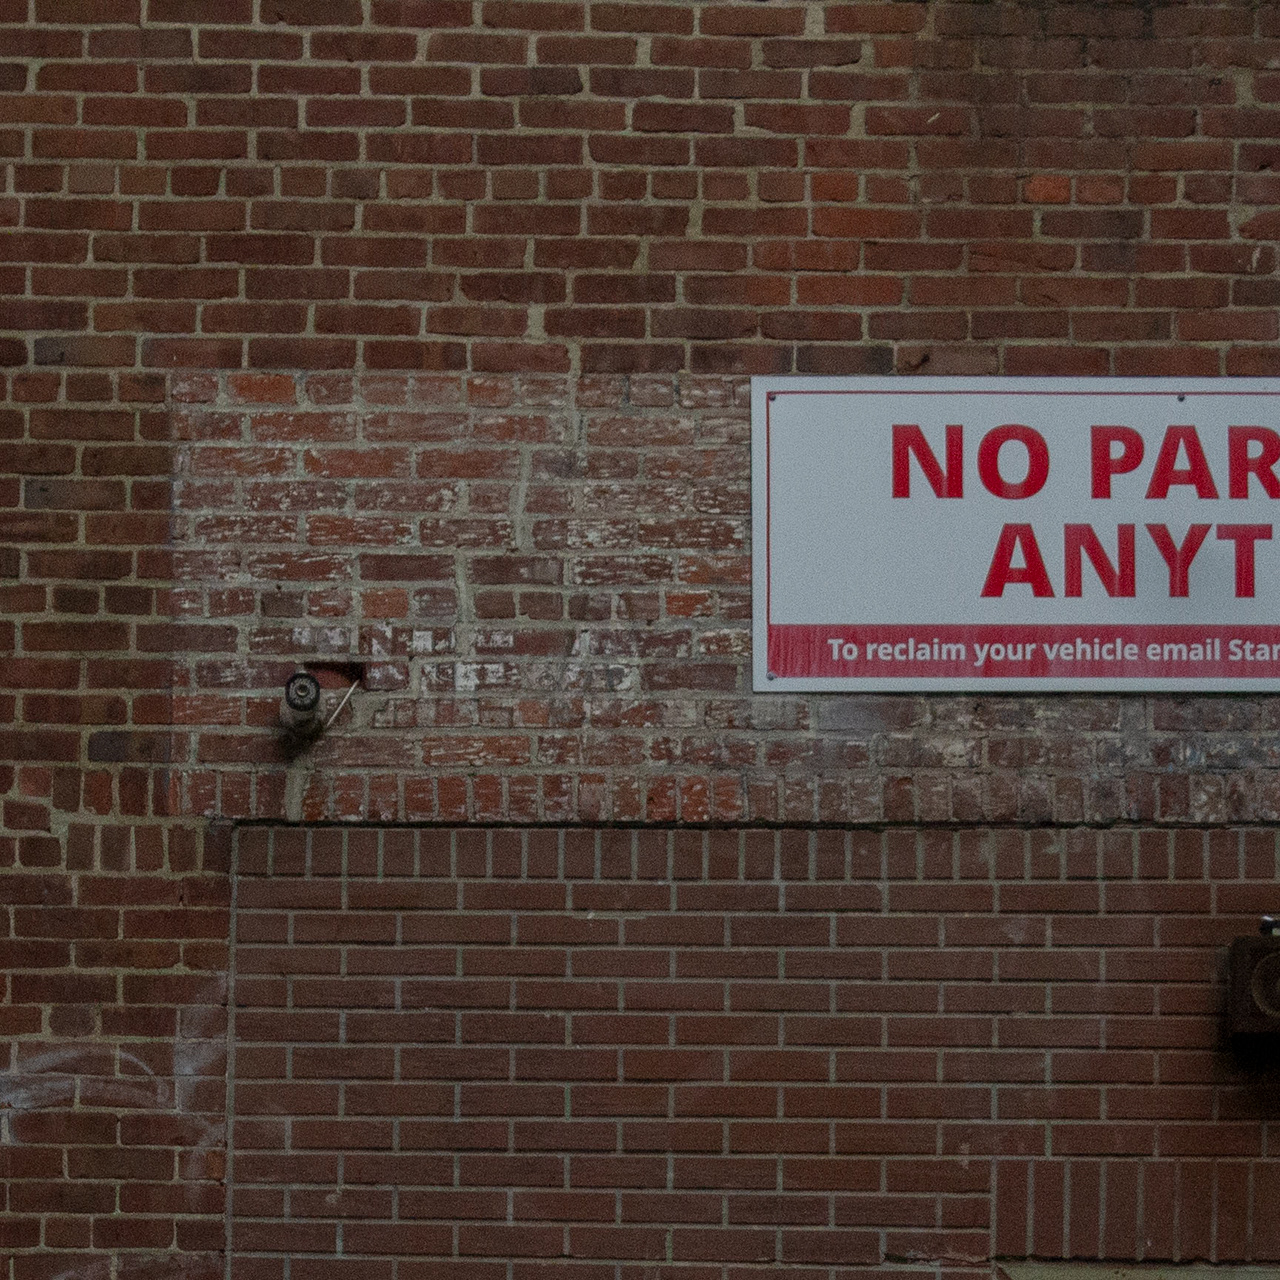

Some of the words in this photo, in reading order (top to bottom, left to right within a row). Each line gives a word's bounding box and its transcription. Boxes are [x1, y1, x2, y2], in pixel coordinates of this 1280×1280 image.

[890, 424, 1051, 500] NO
[827, 638, 858, 661] To
[865, 637, 967, 661] reclaim
[973, 641, 1037, 667] your
[1042, 637, 1139, 661] vehicle
[1146, 637, 1221, 661] email
